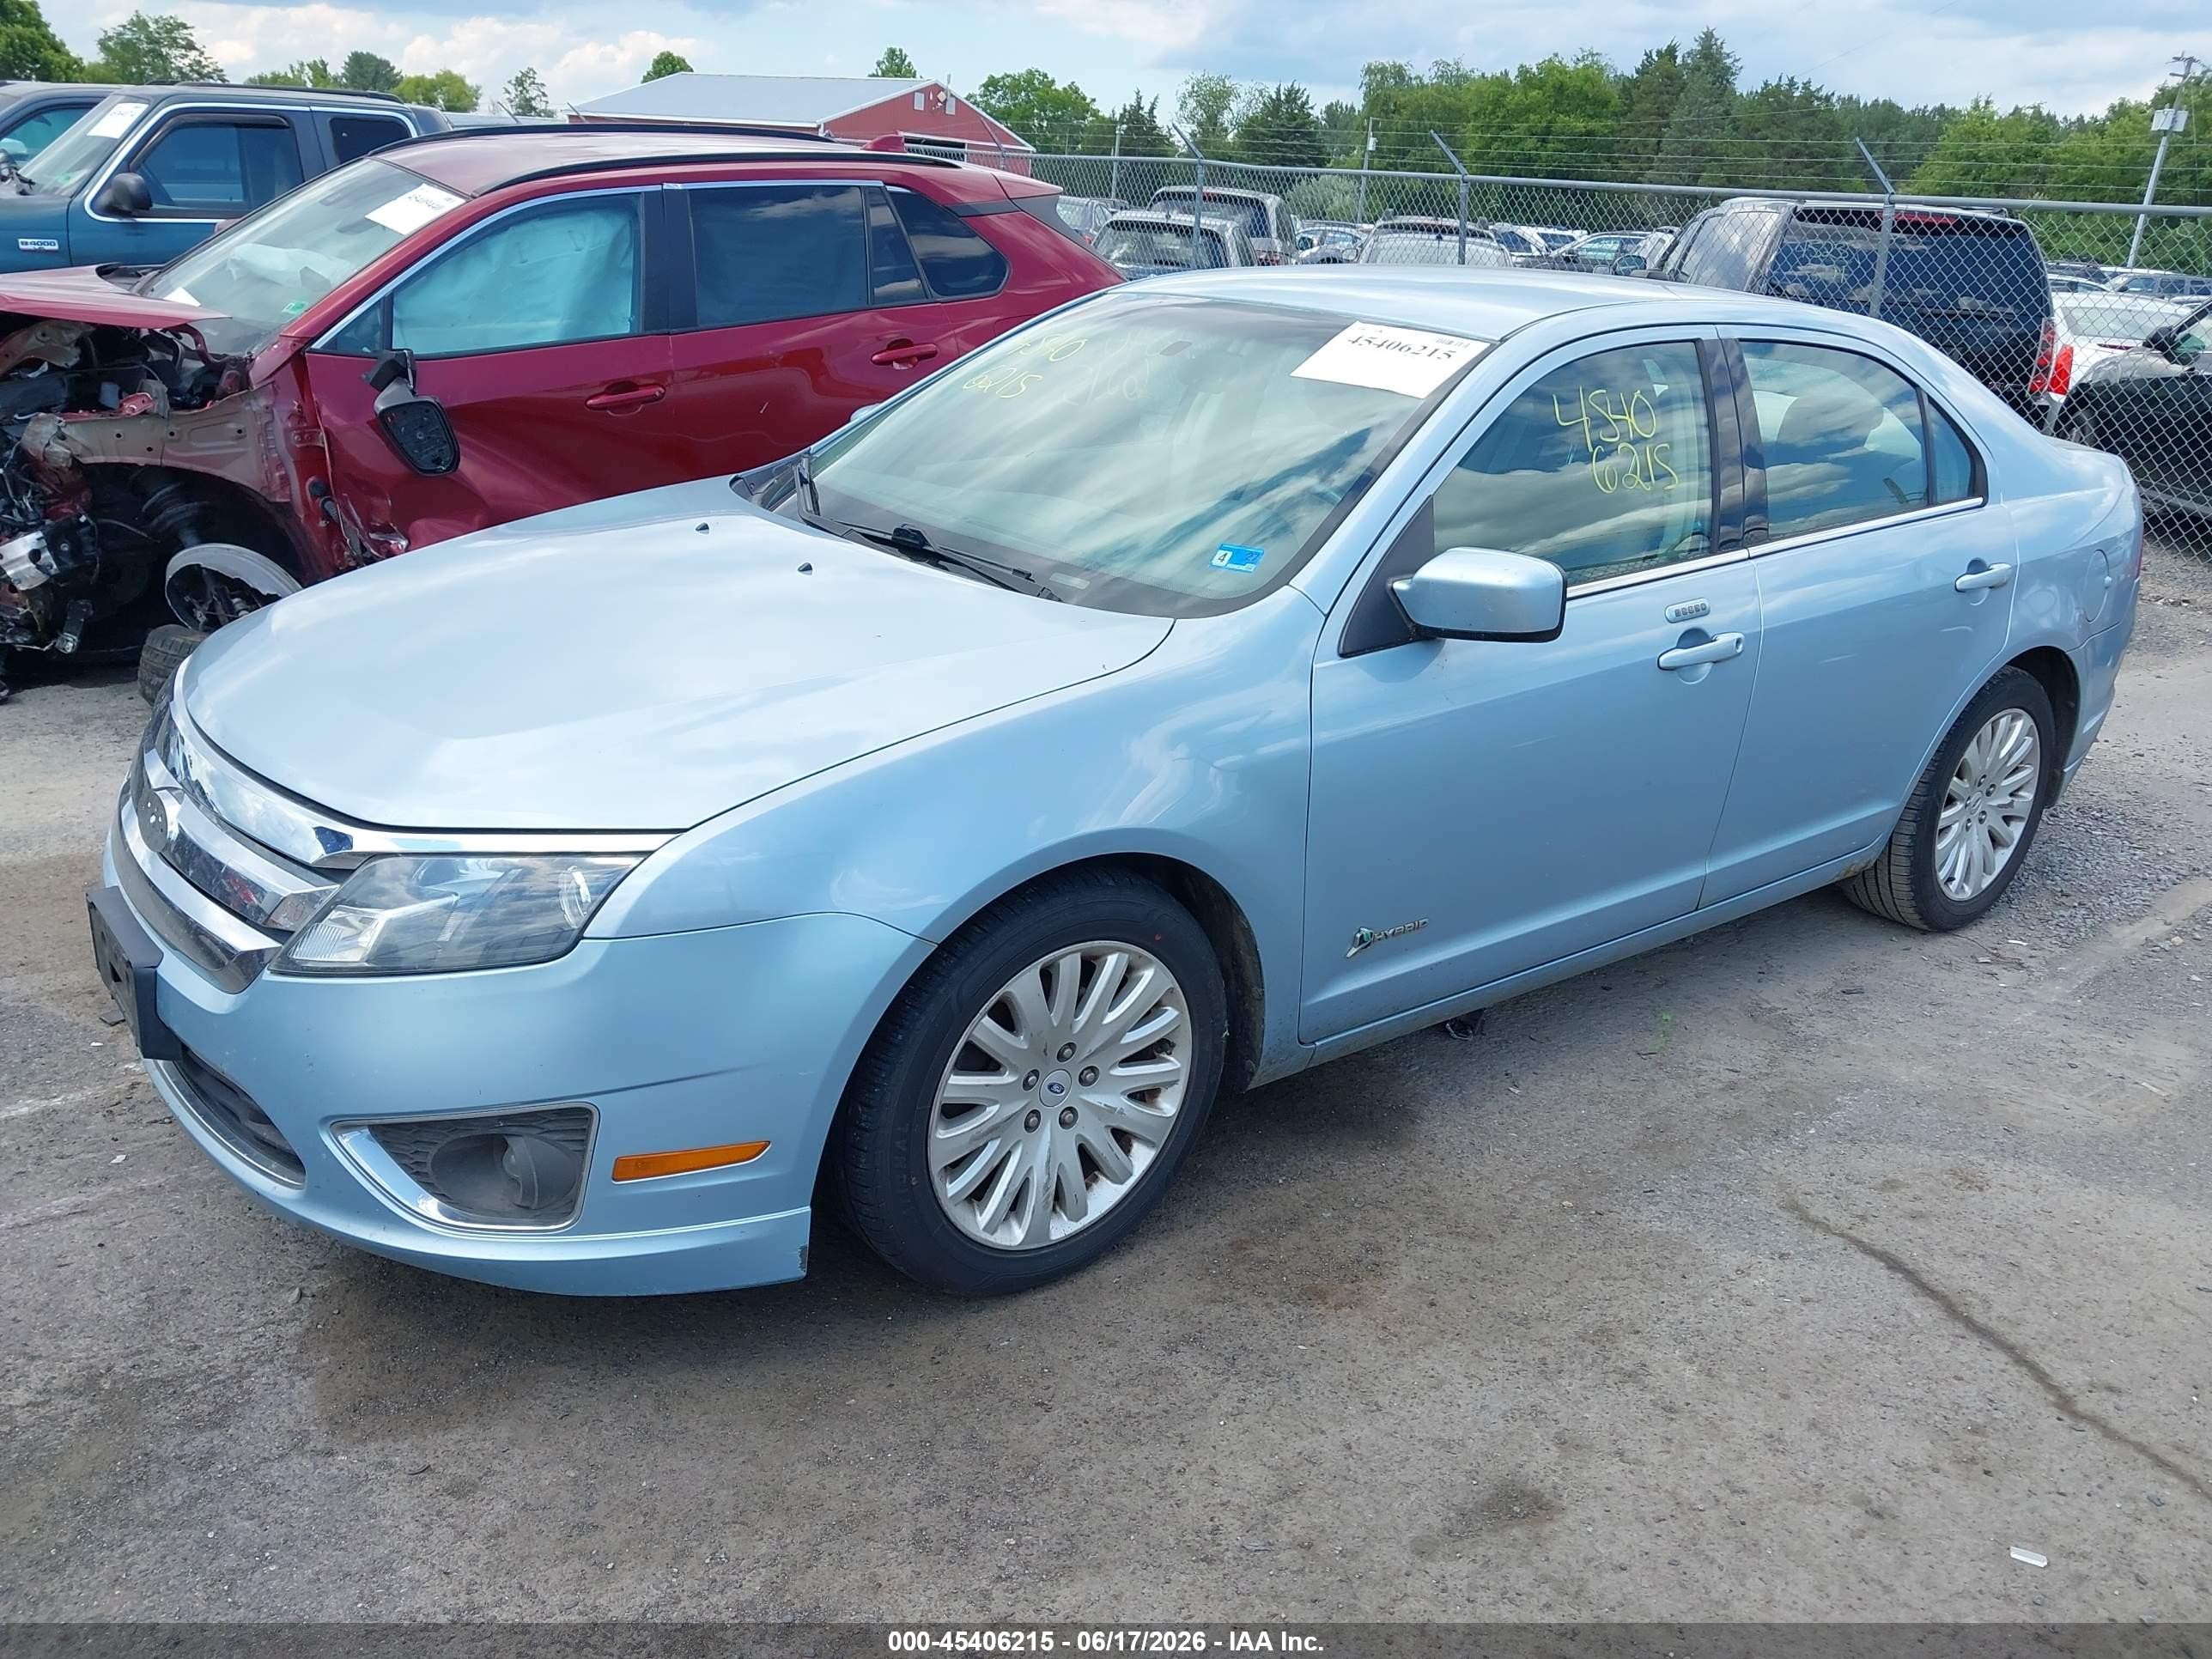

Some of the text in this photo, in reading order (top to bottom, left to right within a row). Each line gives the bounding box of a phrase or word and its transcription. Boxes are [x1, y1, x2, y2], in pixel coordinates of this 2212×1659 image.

[1347, 335, 1456, 360] 45406215
[1553, 386, 1656, 453] 4540
[1593, 442, 1679, 494] 6215
[1218, 552, 1228, 562] 4
[1375, 918, 1429, 940] HYBRID
